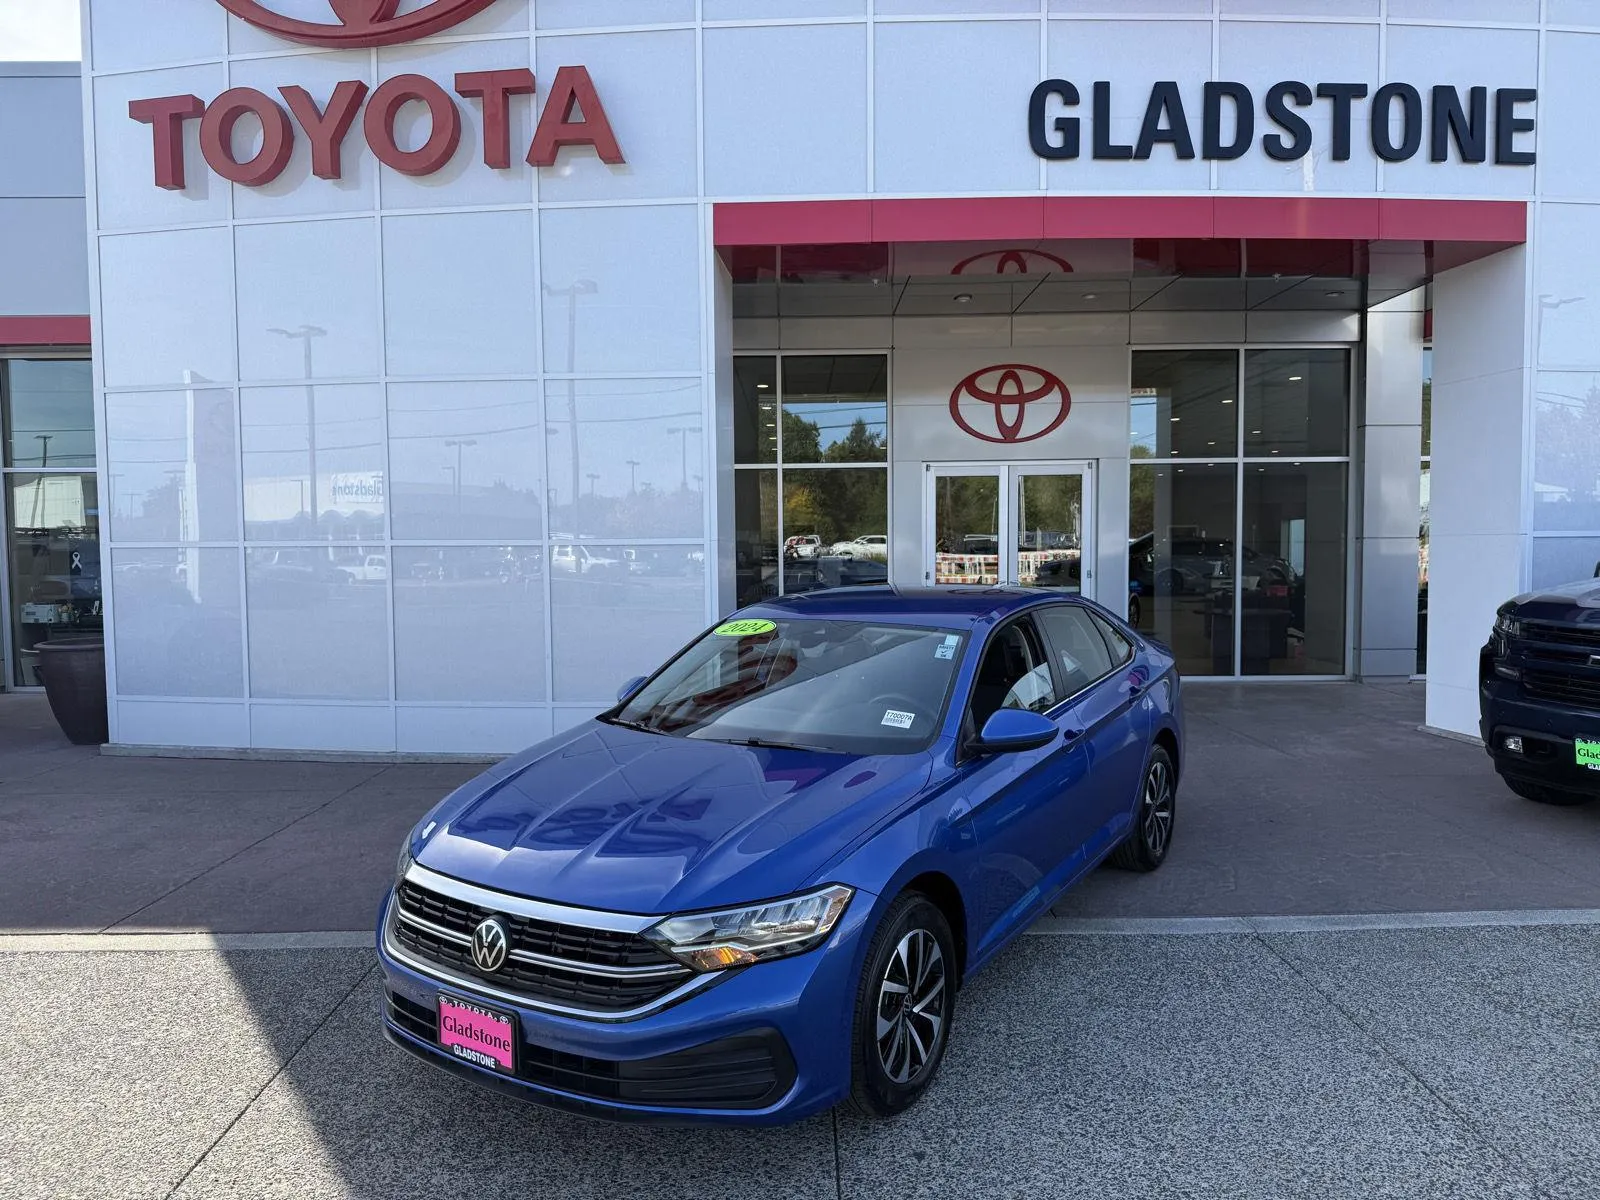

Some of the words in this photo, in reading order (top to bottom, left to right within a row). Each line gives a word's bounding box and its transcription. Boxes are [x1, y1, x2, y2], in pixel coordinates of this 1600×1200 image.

[129, 65, 626, 190] TOYOTA
[1028, 79, 1537, 165] GLADSTONE
[721, 622, 769, 633] 2024
[472, 920, 505, 969] VW
[453, 1000, 493, 1020] TOYOTA
[442, 1015, 511, 1052] Gladstone
[453, 1044, 496, 1068] GLADSTONE
